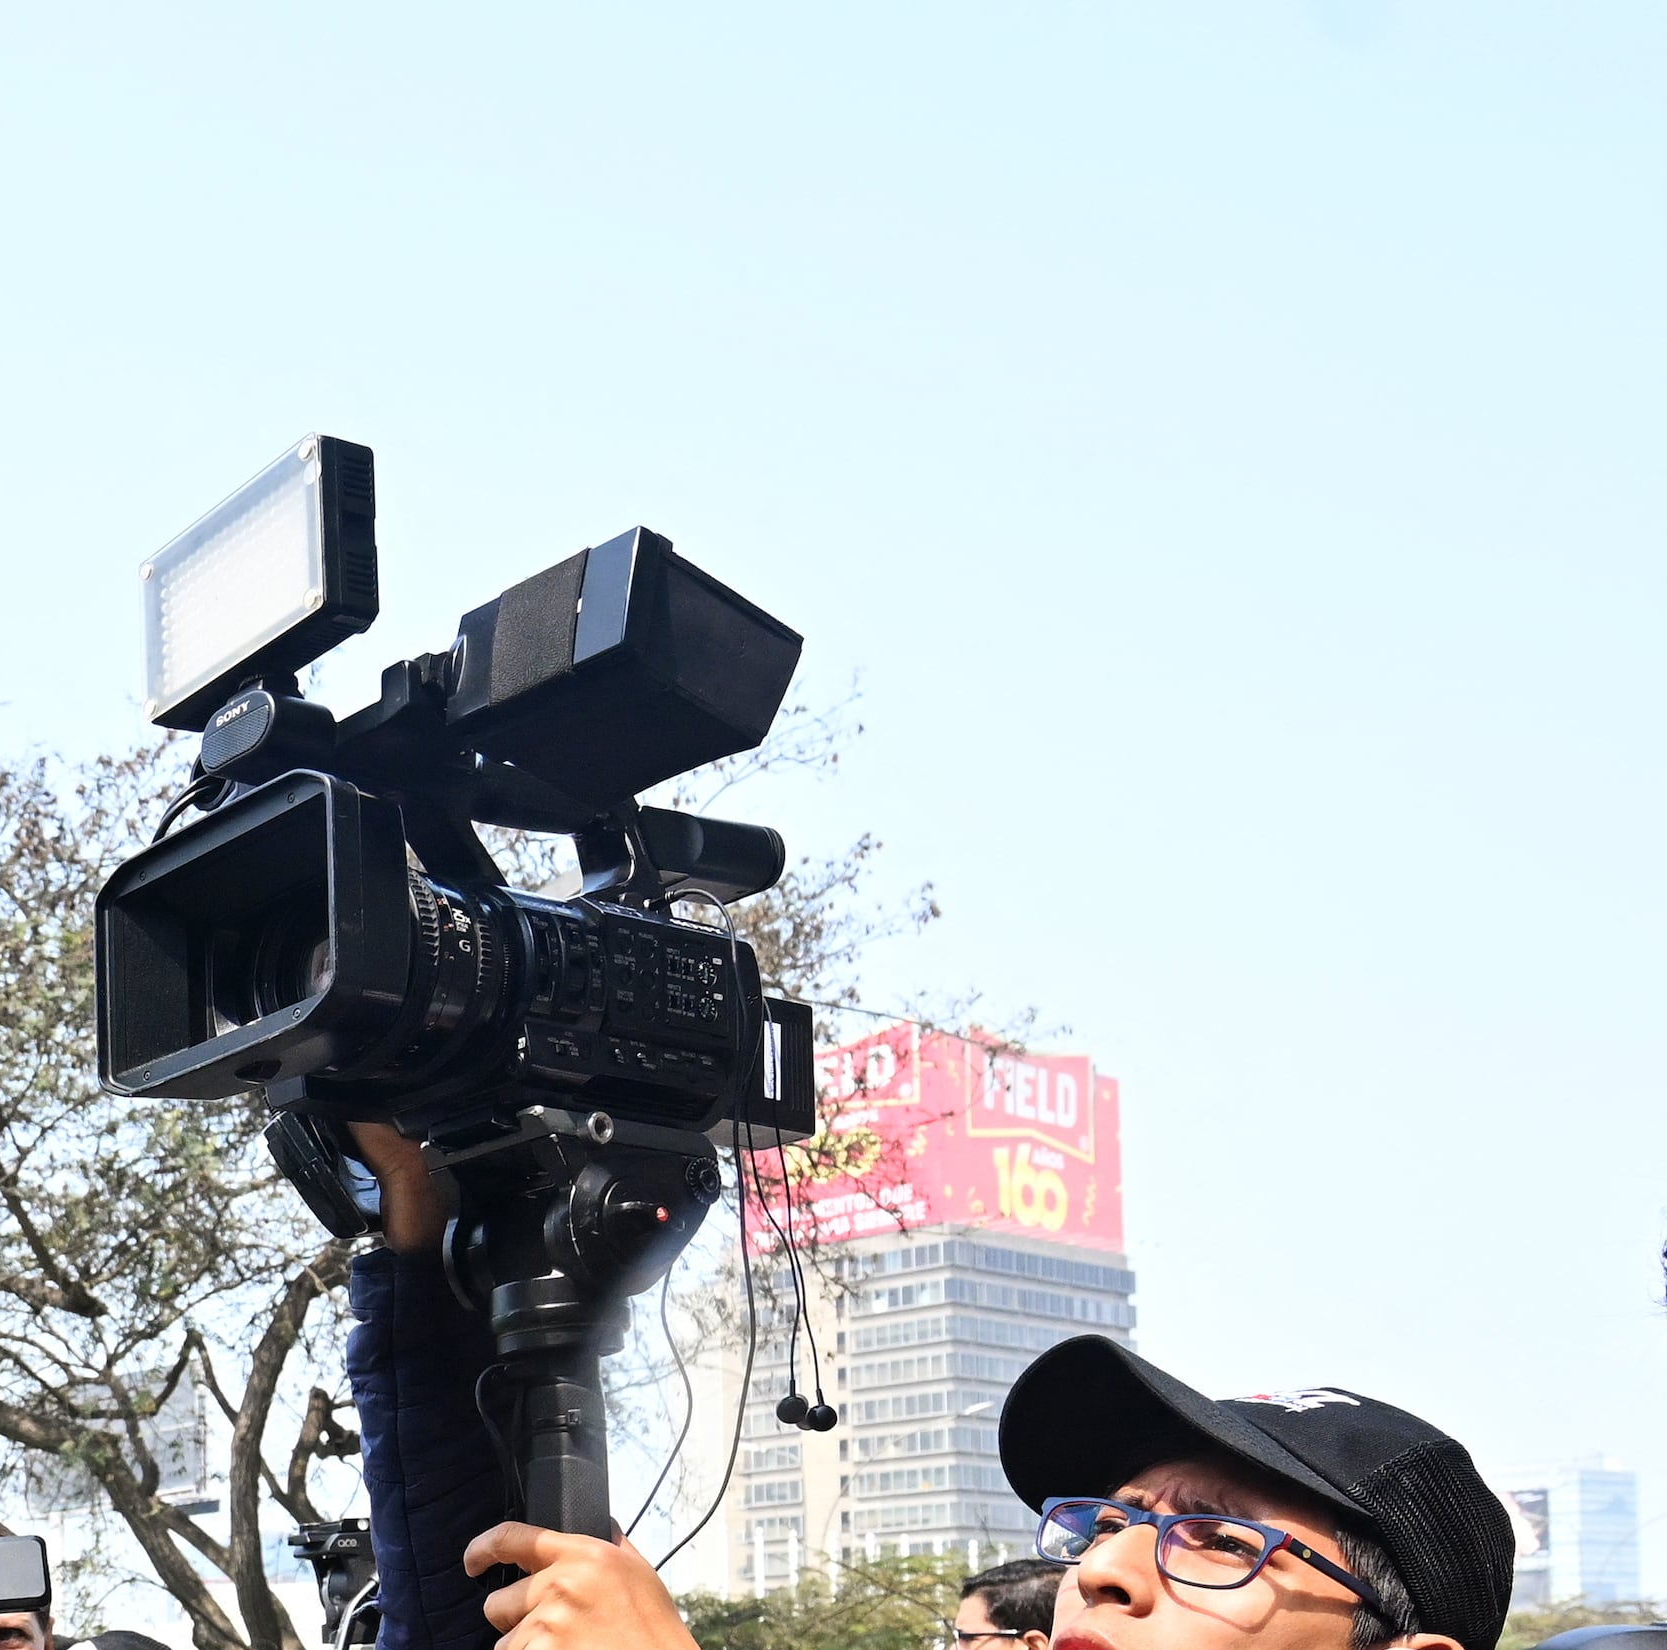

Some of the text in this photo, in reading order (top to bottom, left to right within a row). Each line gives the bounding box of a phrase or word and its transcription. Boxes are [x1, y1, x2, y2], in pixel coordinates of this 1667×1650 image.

[216, 699, 250, 727] SONY
[459, 940, 471, 952] G
[984, 1055, 1077, 1128] FIELD
[993, 1143, 1069, 1231] 160
